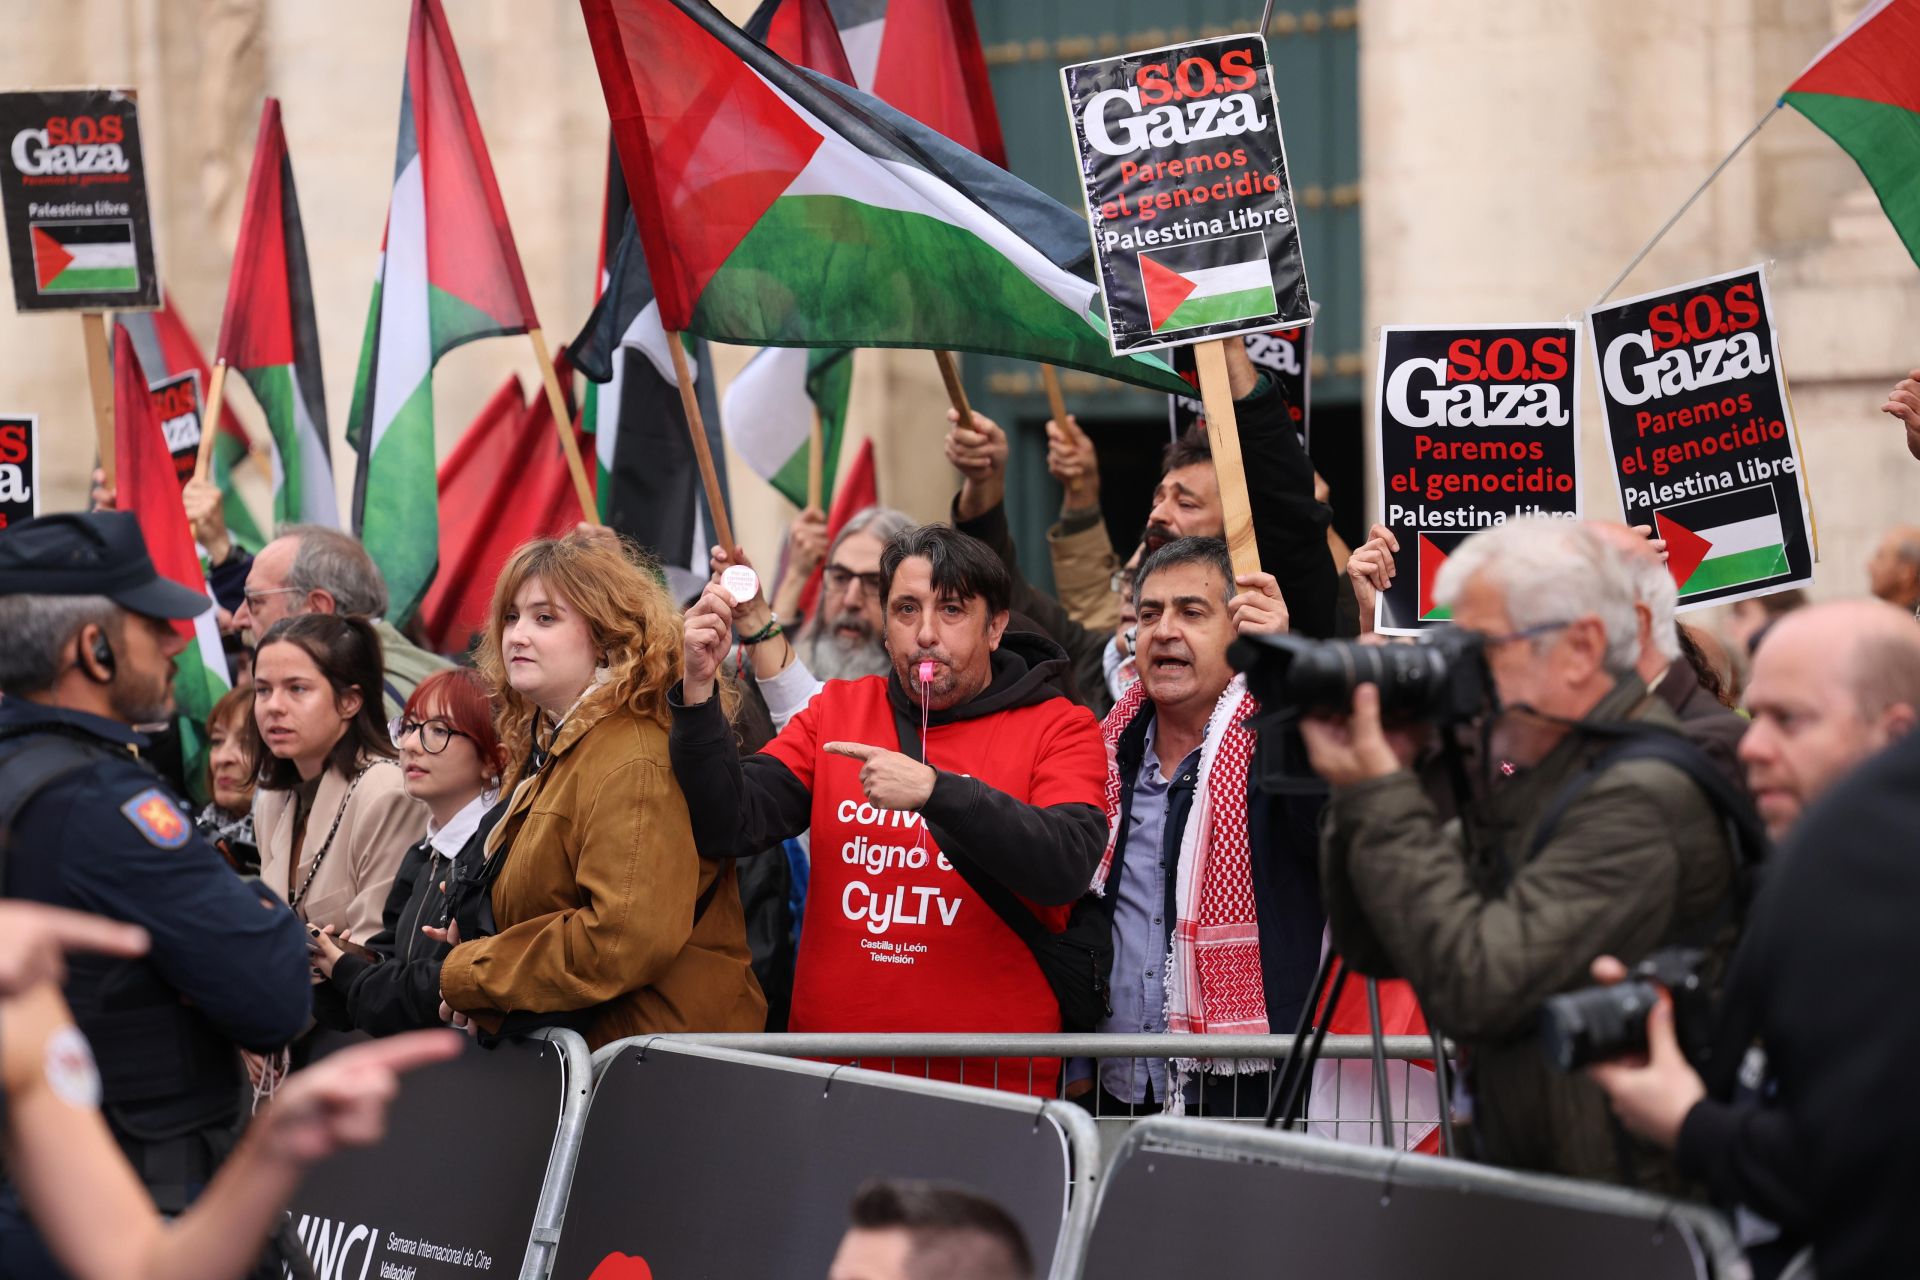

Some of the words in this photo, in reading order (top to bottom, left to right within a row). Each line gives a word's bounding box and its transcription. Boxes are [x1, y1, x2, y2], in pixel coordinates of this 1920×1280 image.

[1136, 49, 1257, 107] S.O.S
[1083, 86, 1267, 156] Gaza
[11, 128, 130, 175] Gaza
[1119, 149, 1248, 186] Paremos
[28, 202, 93, 218] Palestina
[94, 200, 129, 216] libre
[1101, 190, 1131, 220] el
[1138, 171, 1280, 221] genocidio
[1104, 217, 1224, 252] Palestina
[1228, 206, 1290, 231] libre
[1648, 282, 1760, 351] S.O.S
[1245, 333, 1301, 376] za
[1447, 337, 1568, 382] S.O.S
[1603, 328, 1771, 406] Gaza
[1386, 357, 1570, 428] Gaza
[1636, 393, 1753, 438] Paremos
[1415, 435, 1544, 460] Paremos
[1621, 446, 1647, 475] el
[1652, 416, 1785, 476] genocidio
[1391, 467, 1420, 492] el
[1426, 467, 1573, 501] genocidio
[1624, 470, 1734, 511] Palestina
[1736, 455, 1797, 485] libre
[1389, 504, 1507, 527] Palestina
[841, 835, 927, 875] digno
[936, 851, 956, 871] e
[842, 880, 963, 934] CyLTv
[860, 938, 893, 951] Castilla
[895, 943, 902, 953] y
[903, 942, 928, 953] León
[869, 951, 914, 965] Televisión
[380, 1260, 417, 1280] Valladolid
[386, 1231, 417, 1255] Semana
[416, 1238, 464, 1265] Internacional
[463, 1248, 474, 1267] de
[474, 1249, 492, 1270] Cine
